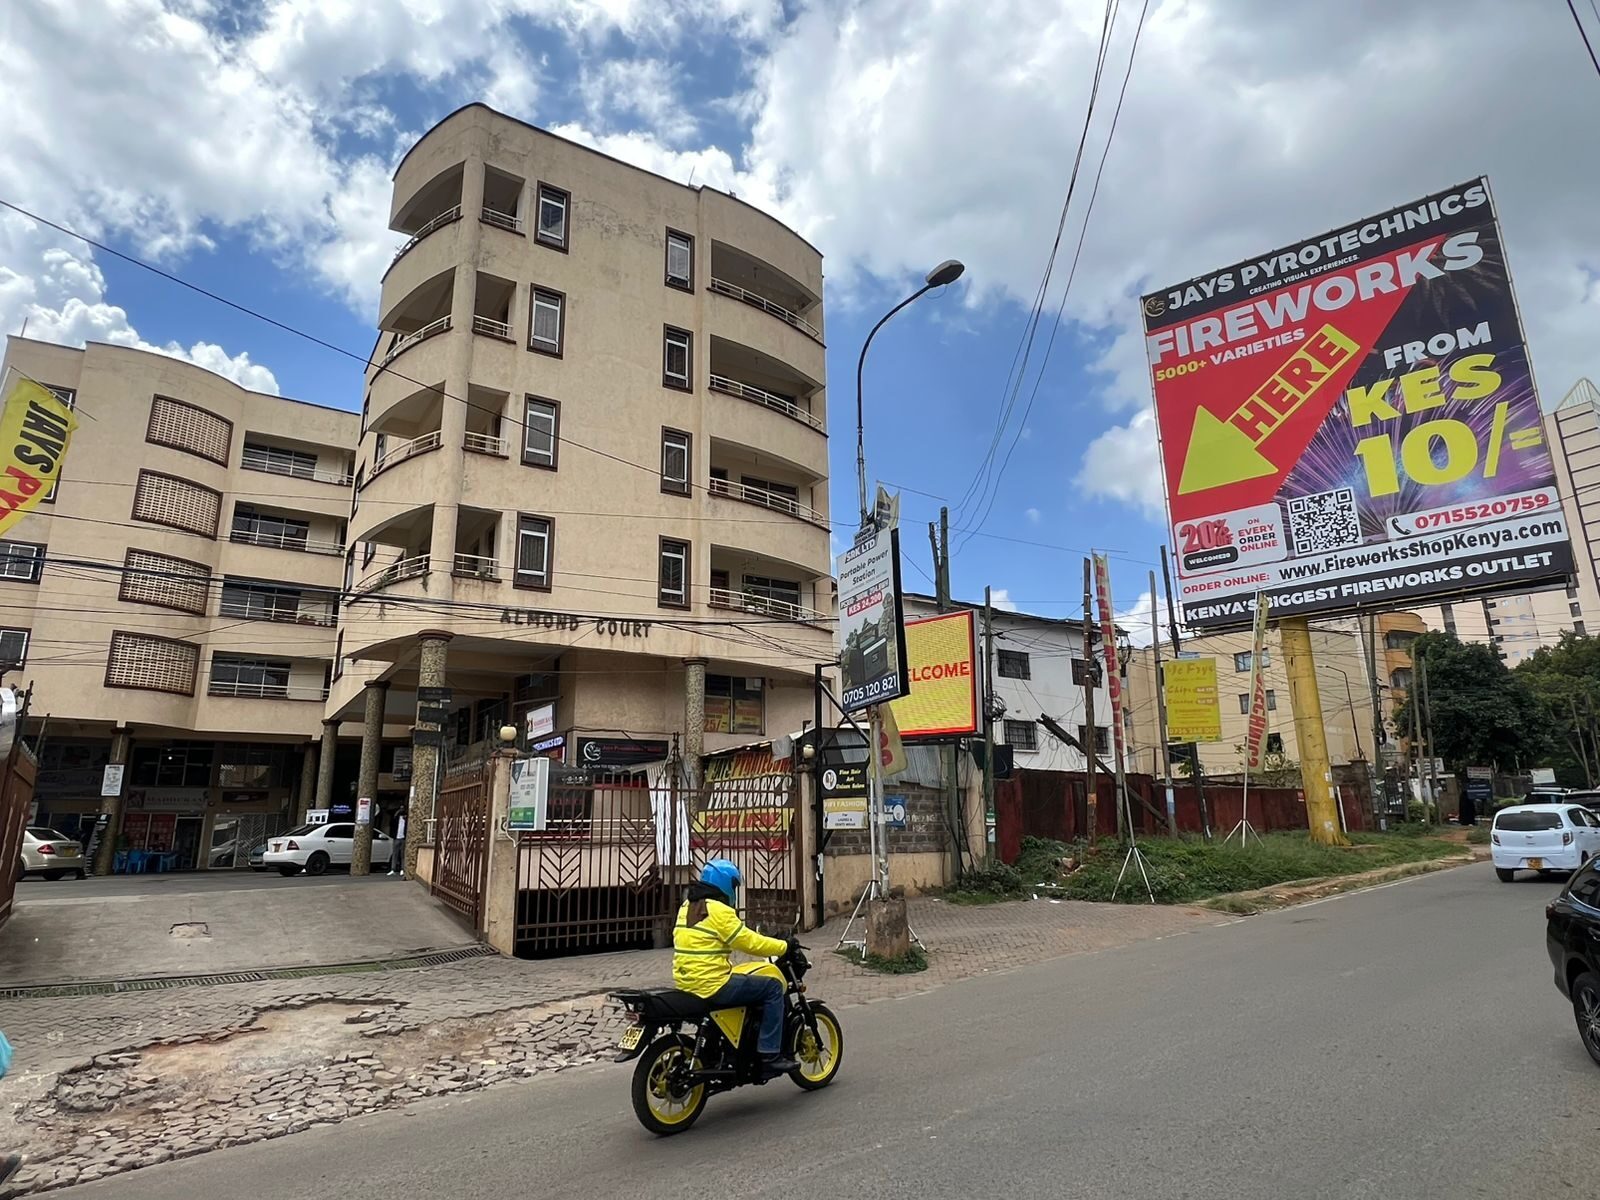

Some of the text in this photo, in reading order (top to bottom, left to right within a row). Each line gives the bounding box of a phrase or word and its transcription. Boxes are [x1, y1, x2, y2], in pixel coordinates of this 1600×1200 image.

[1168, 185, 1487, 310] JAYS PYROTECHNICS
[1147, 231, 1484, 365] FIREWORKS
[1250, 280, 1282, 295] CREATING
[1283, 271, 1309, 284] VISUAL
[1156, 328, 1305, 382] 5000+ VARIETIES
[1383, 321, 1493, 370] FROM
[1230, 332, 1350, 442] HERE
[1346, 353, 1502, 428] KES
[14, 399, 69, 474] JAYS
[1353, 401, 1542, 498] 10/=
[1414, 493, 1550, 530] 0715520759
[861, 539, 875, 553] LTD
[1179, 518, 1230, 554] 20%
[1238, 523, 1274, 537] EVERY
[1239, 531, 1276, 545] ORDER
[1240, 539, 1278, 552] ONLINE
[839, 561, 867, 581] Portable
[852, 568, 876, 586] Station
[1183, 581, 1221, 594] ORDER
[1223, 572, 1270, 587] ONLINE:
[1186, 599, 1259, 621] KENYA'S
[1341, 565, 1464, 597] FIREWORKS
[1466, 551, 1553, 577] OUTLET
[500, 607, 652, 637] ALMOND COURT
[843, 687, 864, 705] 0705
[865, 680, 881, 697] 120
[882, 675, 897, 691] 821
